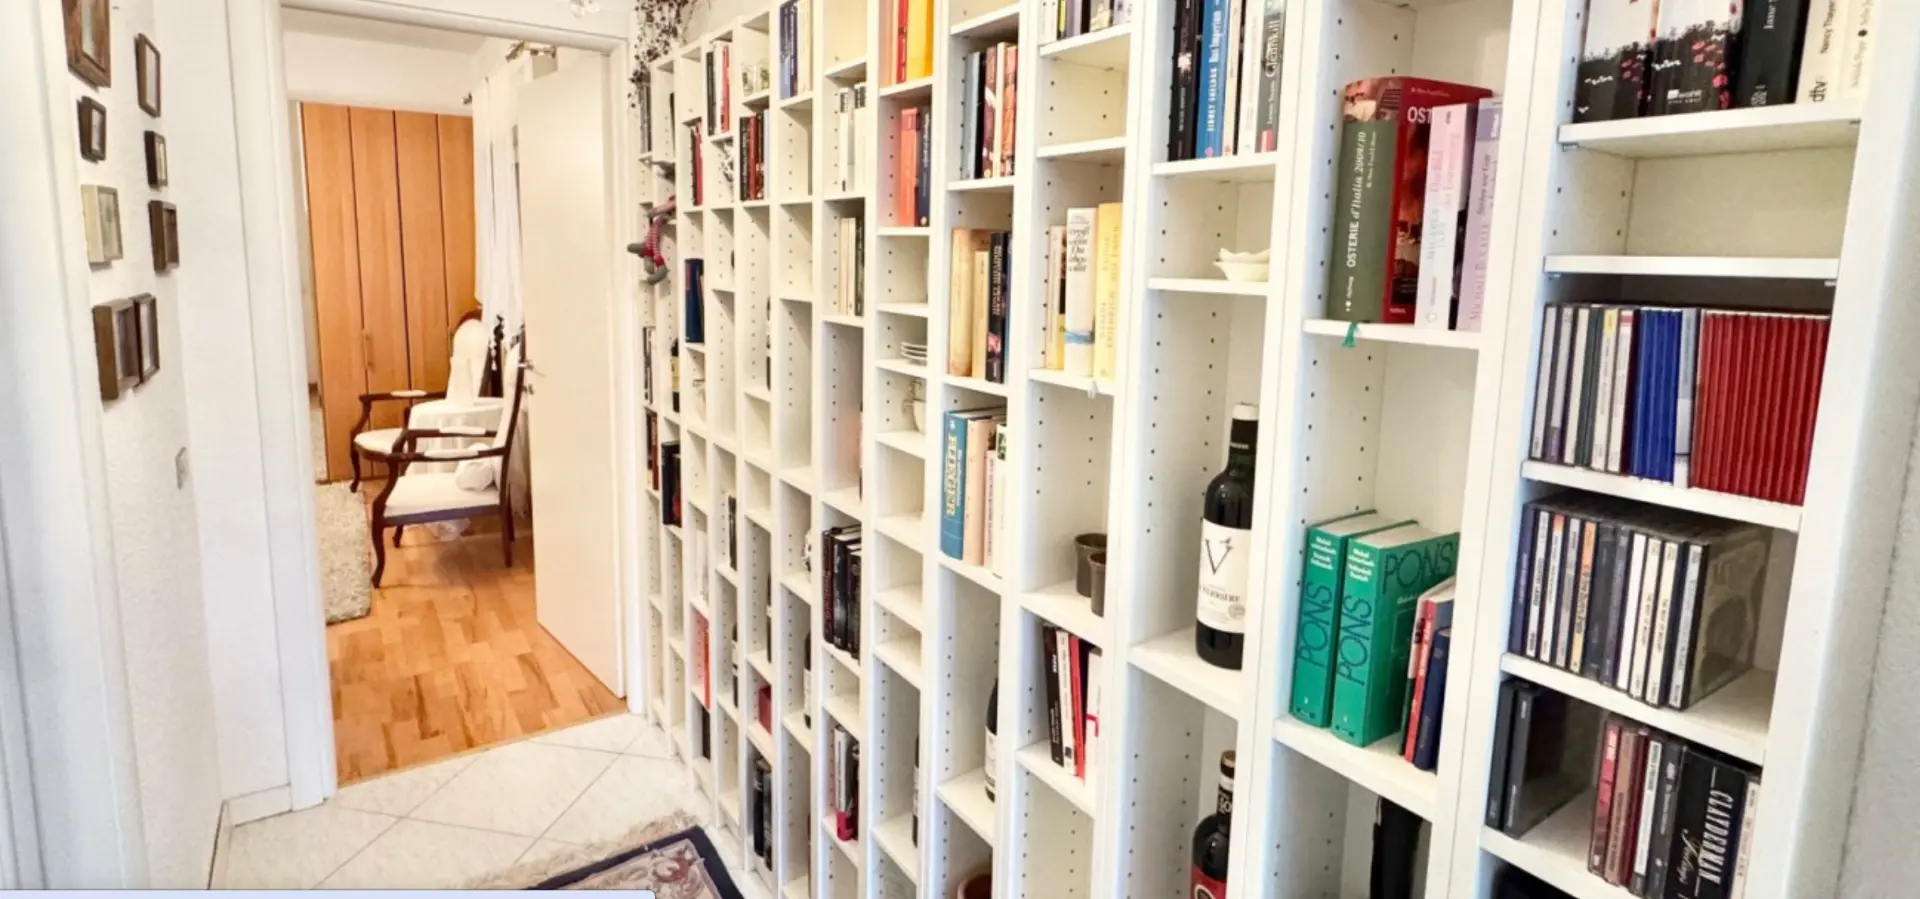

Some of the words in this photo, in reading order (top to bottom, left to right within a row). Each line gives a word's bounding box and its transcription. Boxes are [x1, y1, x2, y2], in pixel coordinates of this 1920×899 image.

[1809, 80, 1827, 102] dtv
[1350, 177, 1363, 218] d'Italia
[1347, 221, 1359, 268] OSTERIE
[1383, 542, 1454, 595] PONS
[1297, 583, 1333, 669] PONS
[1336, 594, 1372, 686] PONS
[1698, 790, 1734, 886] CLAYDERMAN
